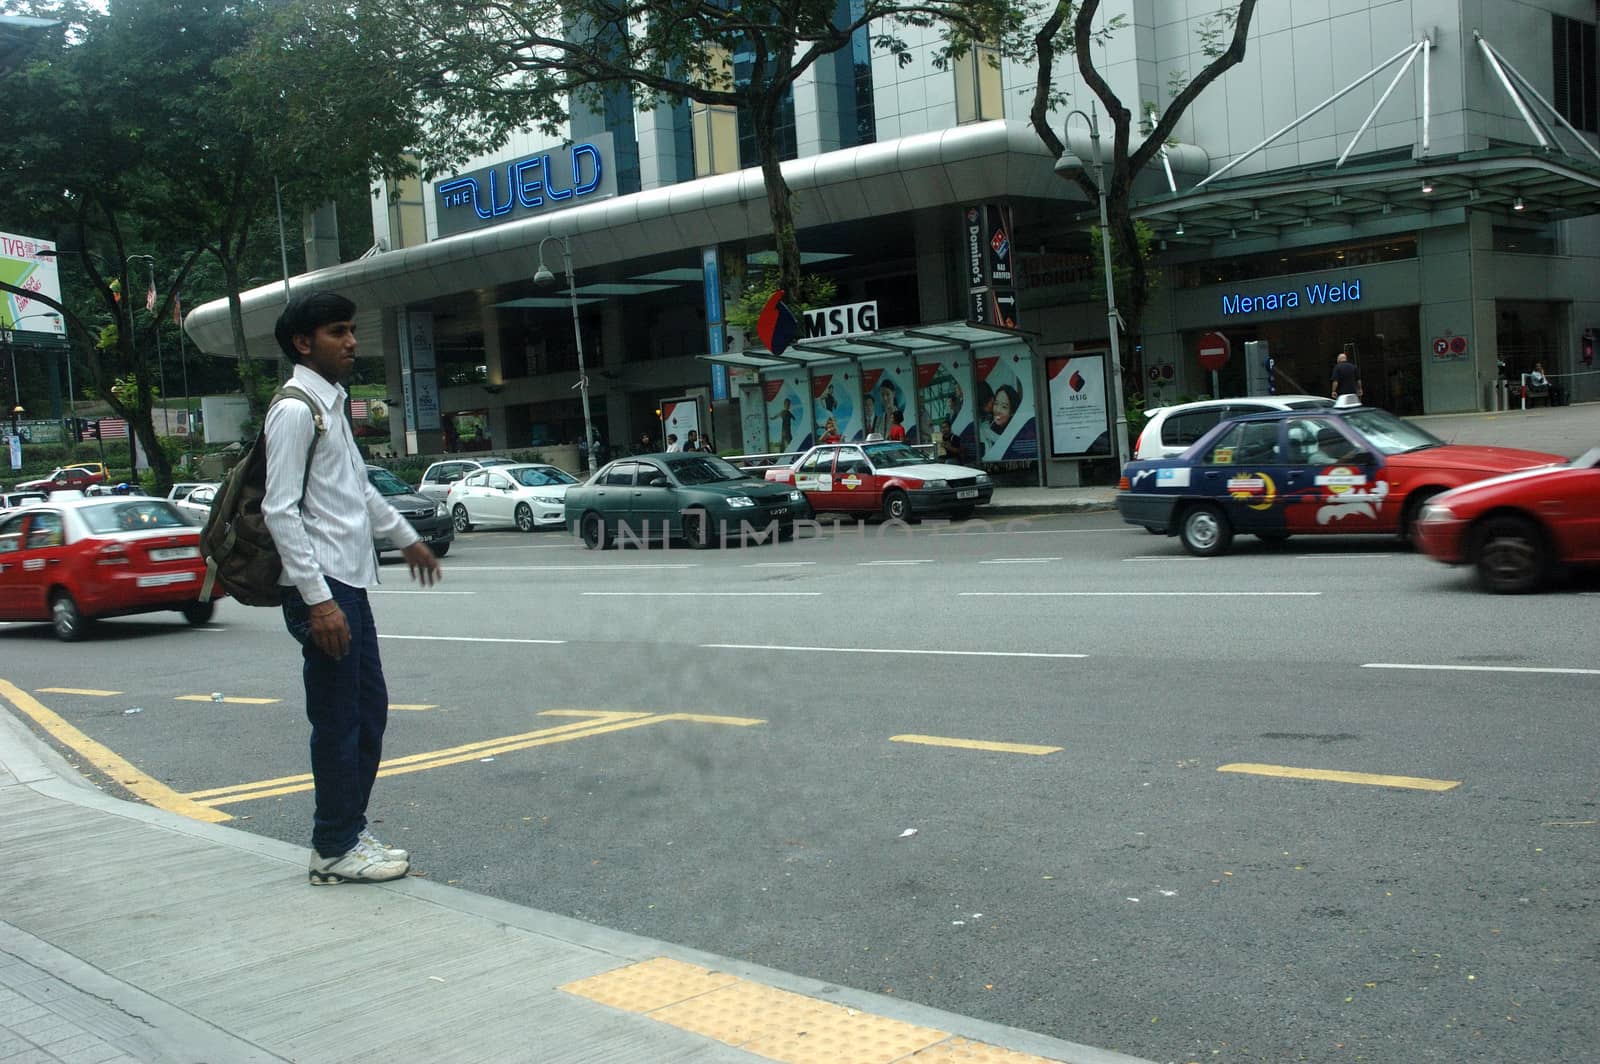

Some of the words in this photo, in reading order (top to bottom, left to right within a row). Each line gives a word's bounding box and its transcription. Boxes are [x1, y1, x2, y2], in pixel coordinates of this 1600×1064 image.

[440, 143, 601, 219] WELD
[443, 192, 470, 208] THE
[0, 237, 25, 257] TVB
[969, 225, 982, 284] Domino's
[1222, 291, 1299, 315] Menara
[1305, 280, 1361, 305] Weld
[801, 304, 876, 338] MSIG
